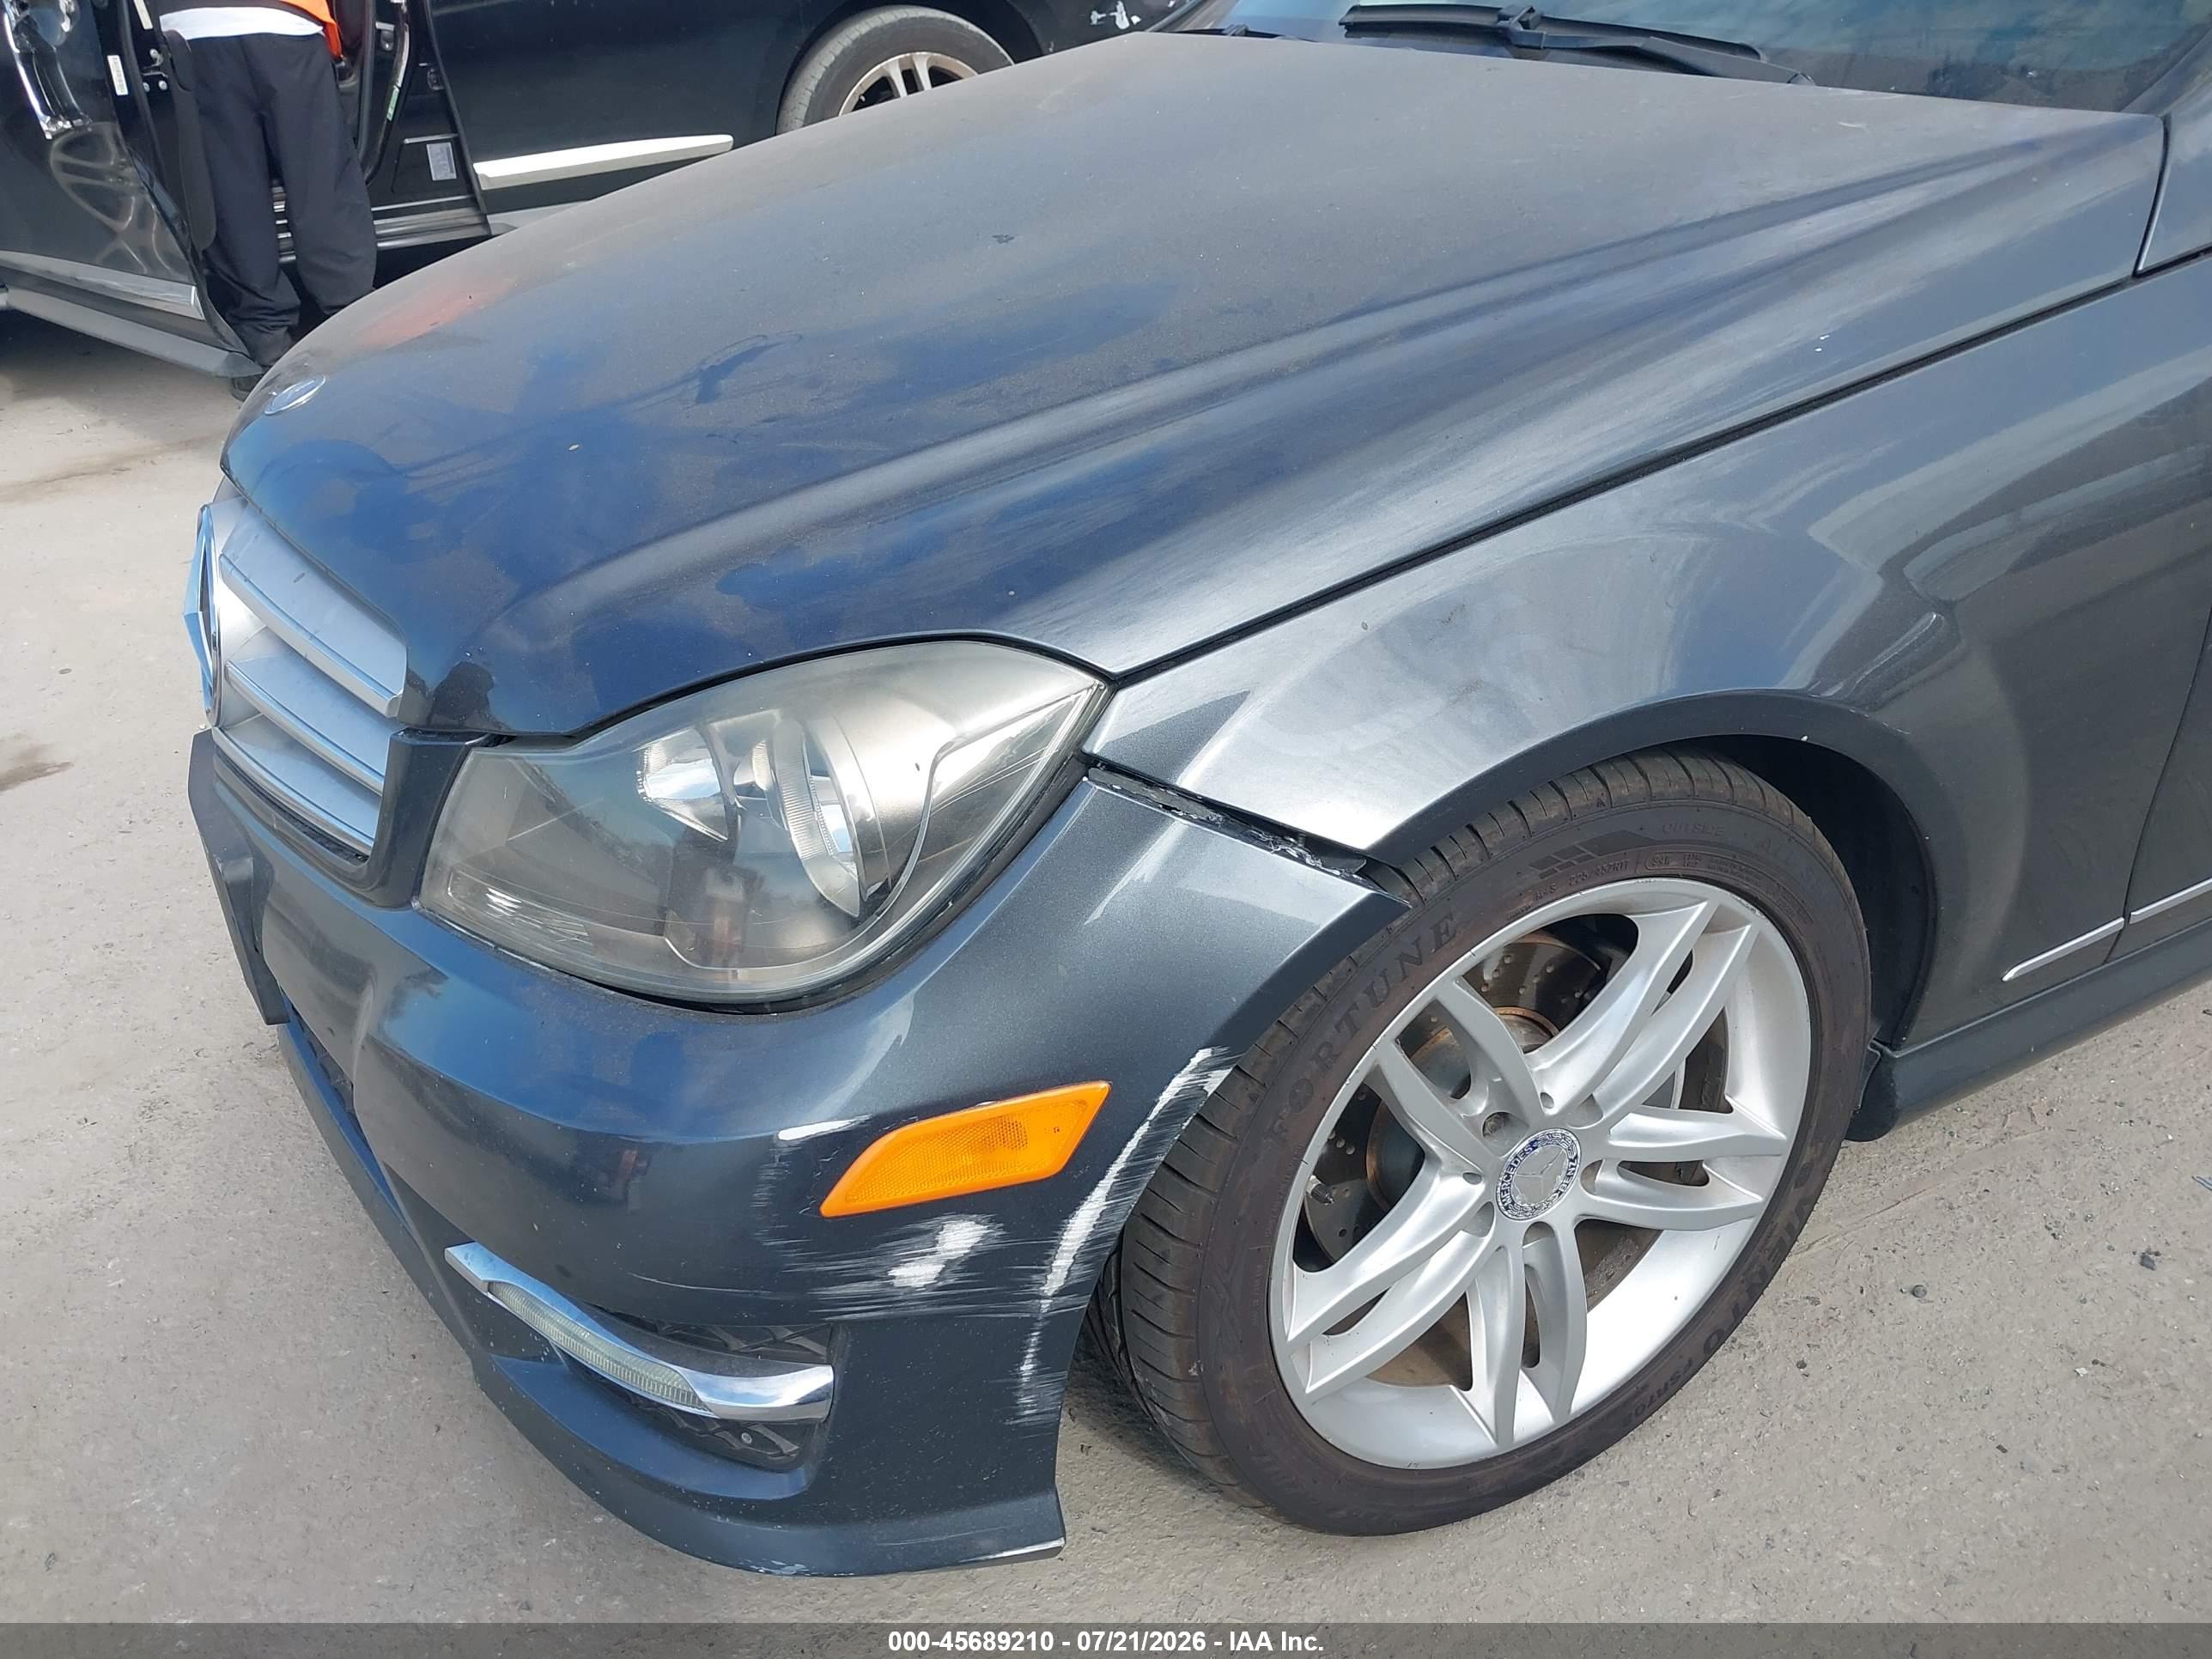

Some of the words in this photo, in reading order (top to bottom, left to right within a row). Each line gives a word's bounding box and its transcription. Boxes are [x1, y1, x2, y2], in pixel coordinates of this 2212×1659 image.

[1267, 909, 1457, 1140] FORTUNE
[1500, 1146, 1534, 1206] MERCEDES
[1559, 1159, 1578, 1192] BENZ
